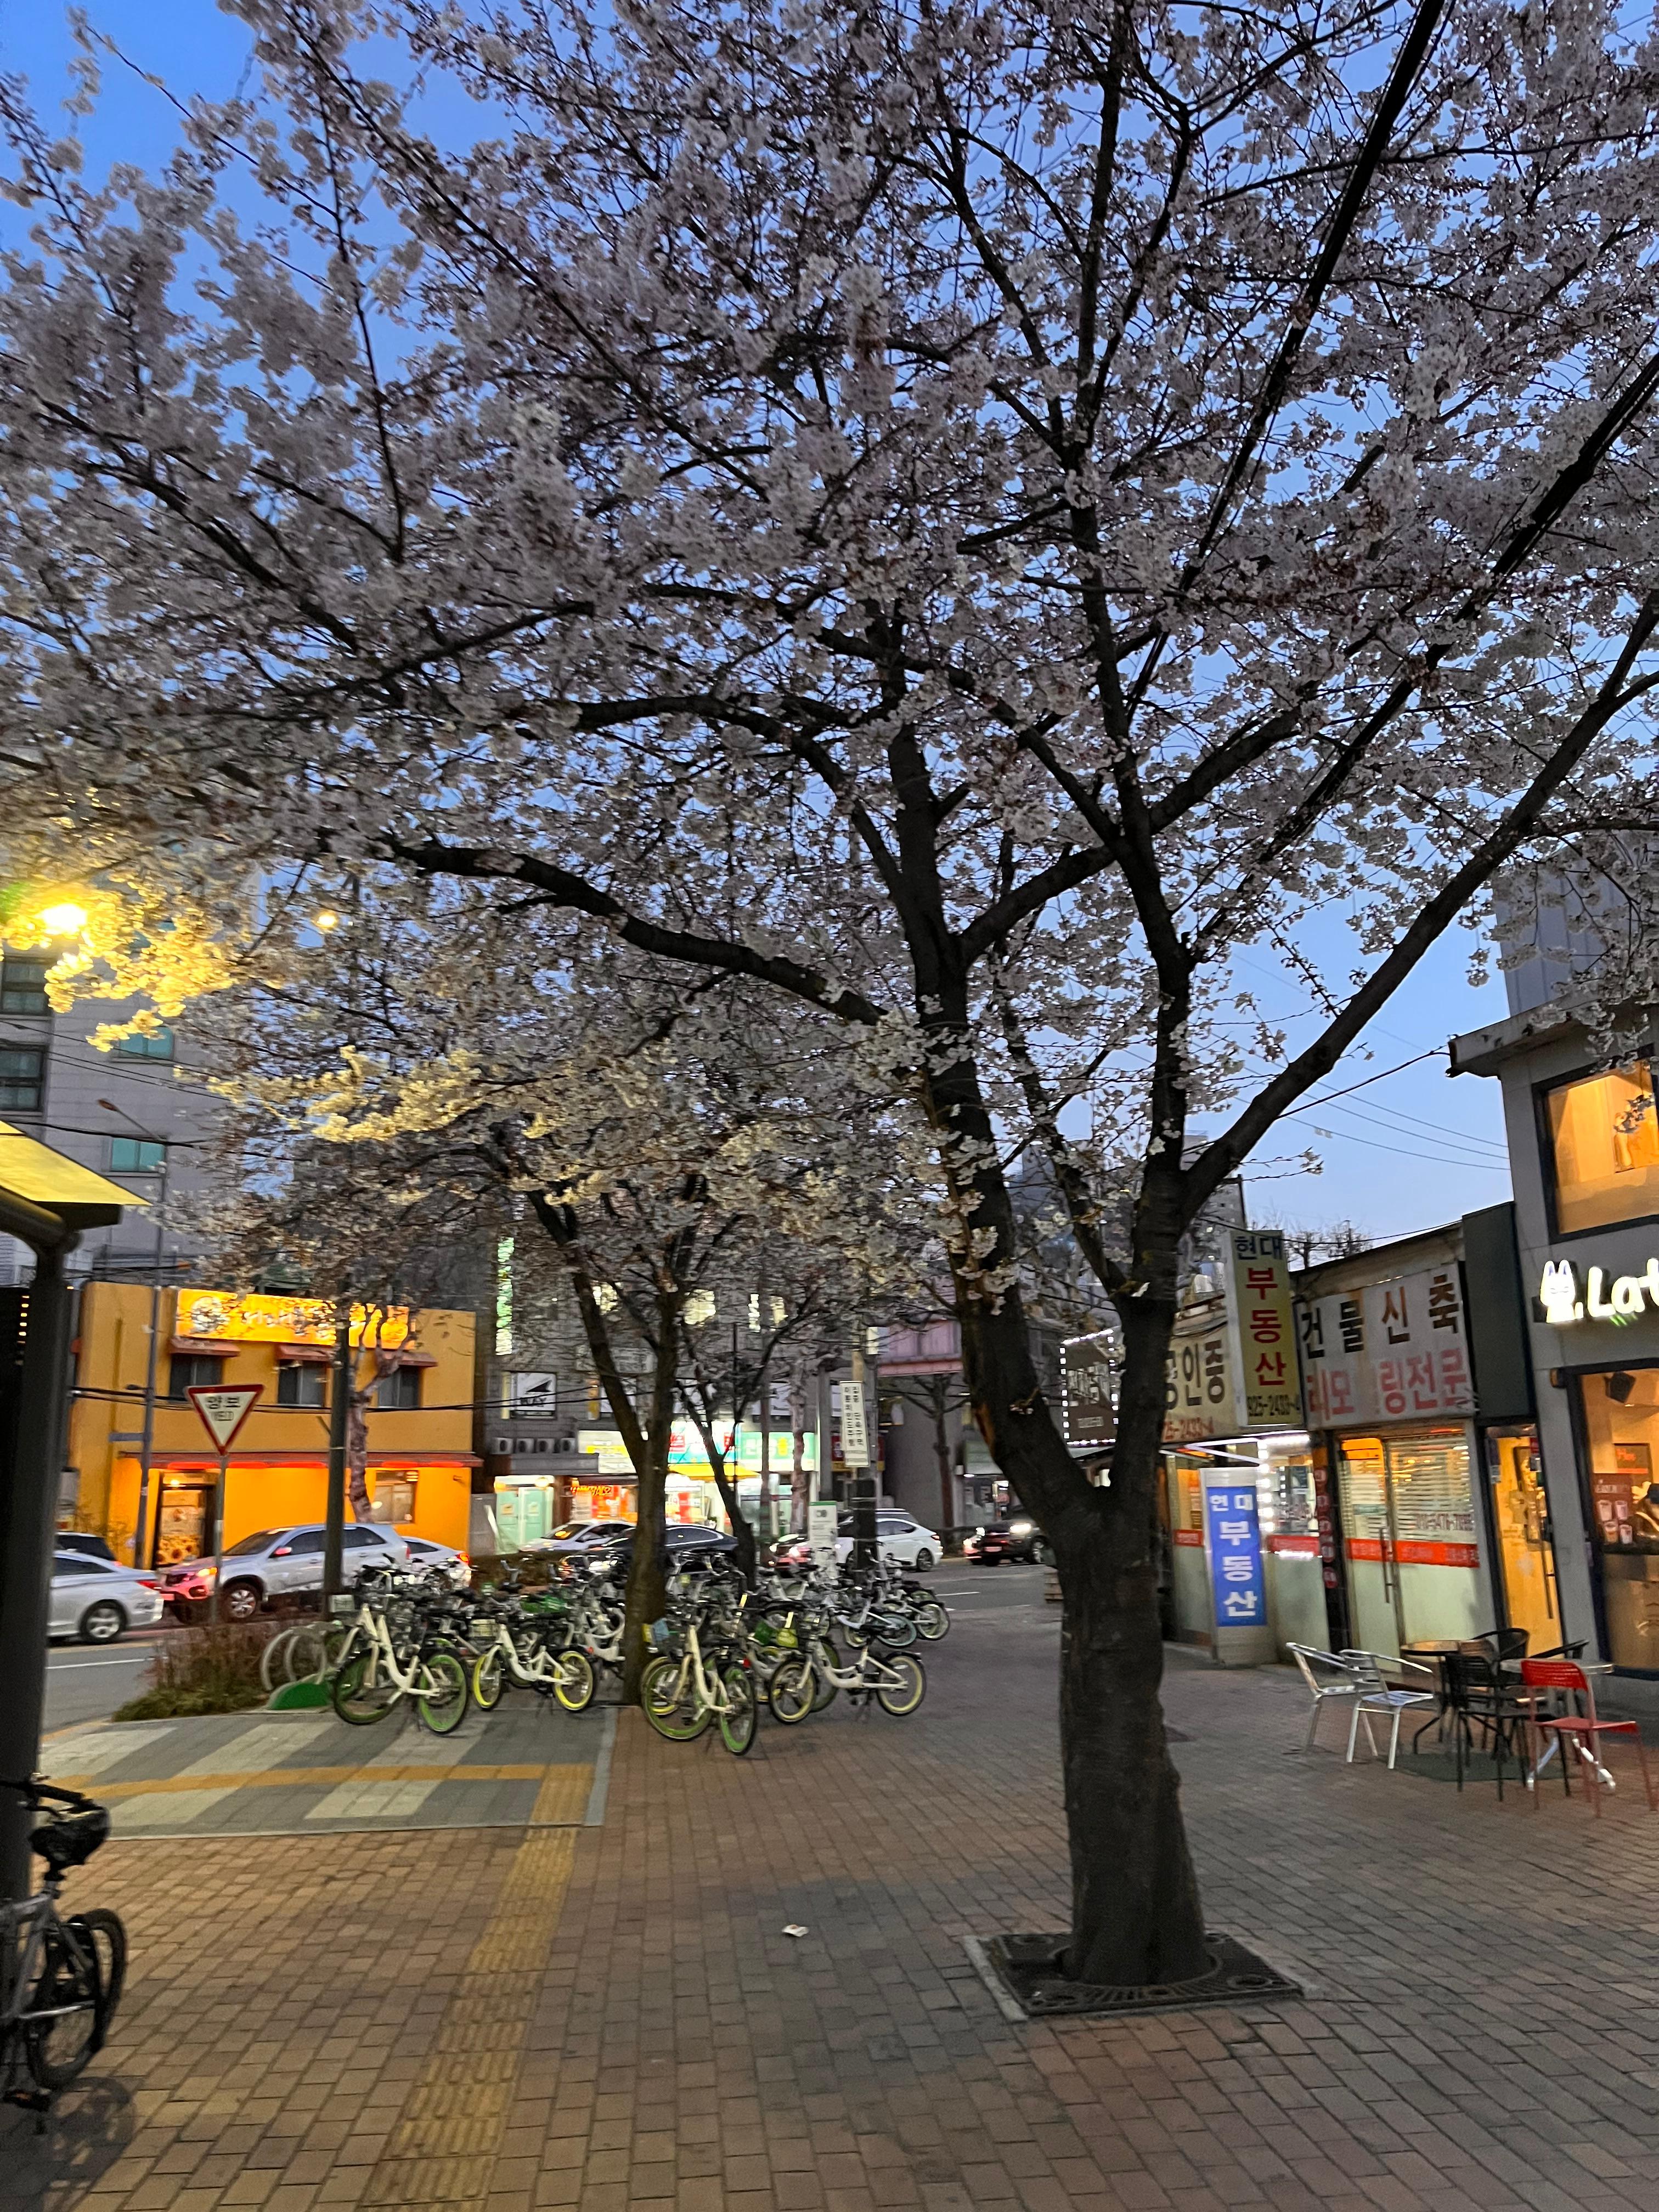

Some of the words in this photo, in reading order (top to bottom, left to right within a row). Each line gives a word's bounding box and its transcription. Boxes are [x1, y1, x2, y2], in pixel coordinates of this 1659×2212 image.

[1234, 1235, 1283, 1260] 현대
[1246, 1267, 1288, 1386] 부동산
[1301, 1273, 1459, 1359] 건물신축
[205, 1396, 241, 1409] 양보
[1219, 1521, 1258, 1617] 부동산
